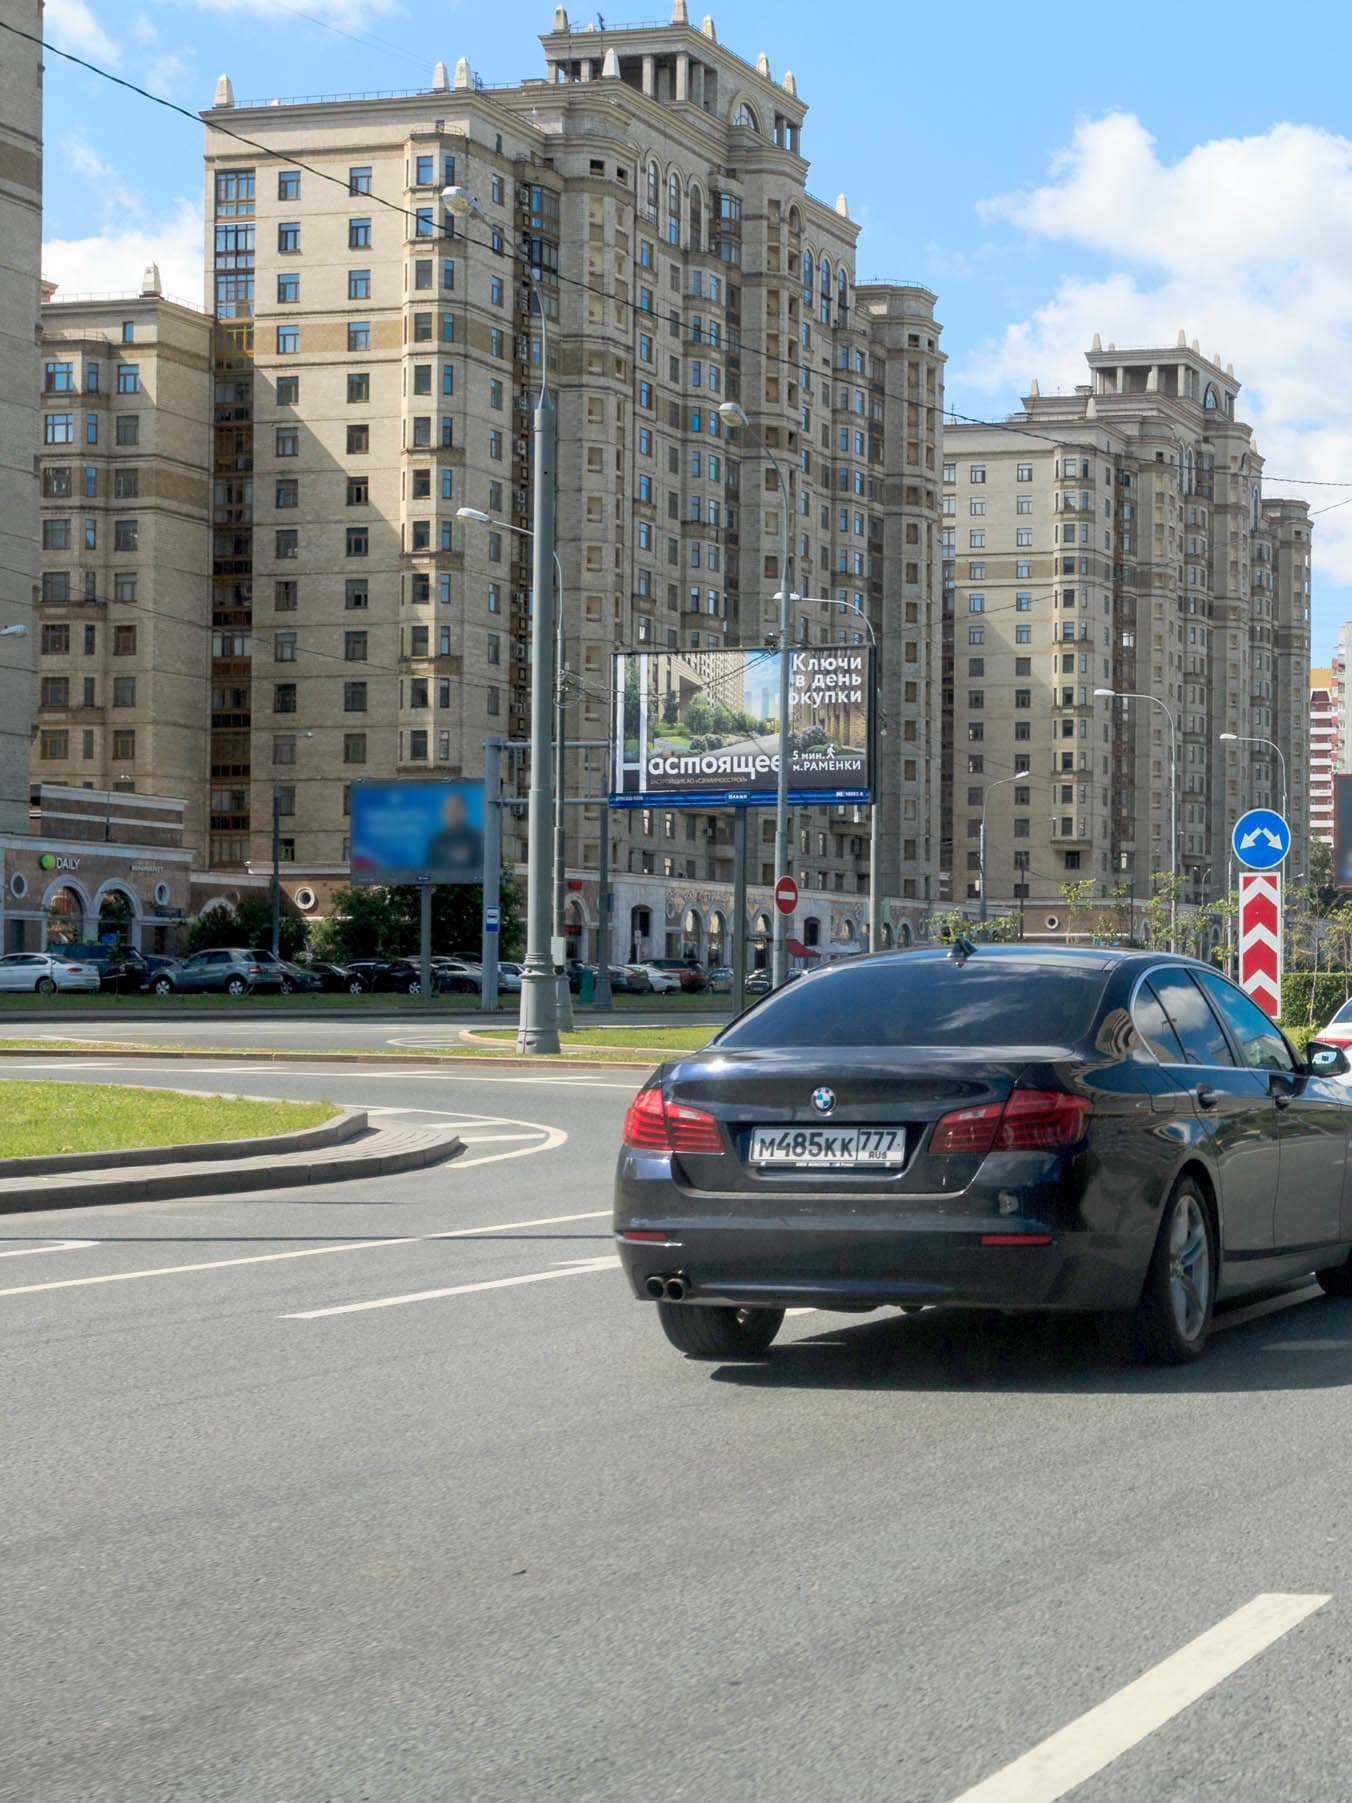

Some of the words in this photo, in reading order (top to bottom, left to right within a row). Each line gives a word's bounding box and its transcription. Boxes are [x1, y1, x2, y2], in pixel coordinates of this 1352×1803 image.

[792, 652, 862, 671] Ключи
[795, 675, 806, 687] в
[812, 673, 862, 689] день
[792, 750, 799, 760] 5
[801, 752, 825, 760] мин.
[56, 857, 80, 870] DAILY
[860, 1131, 898, 1151] 777
[868, 1151, 887, 1160] RUS
